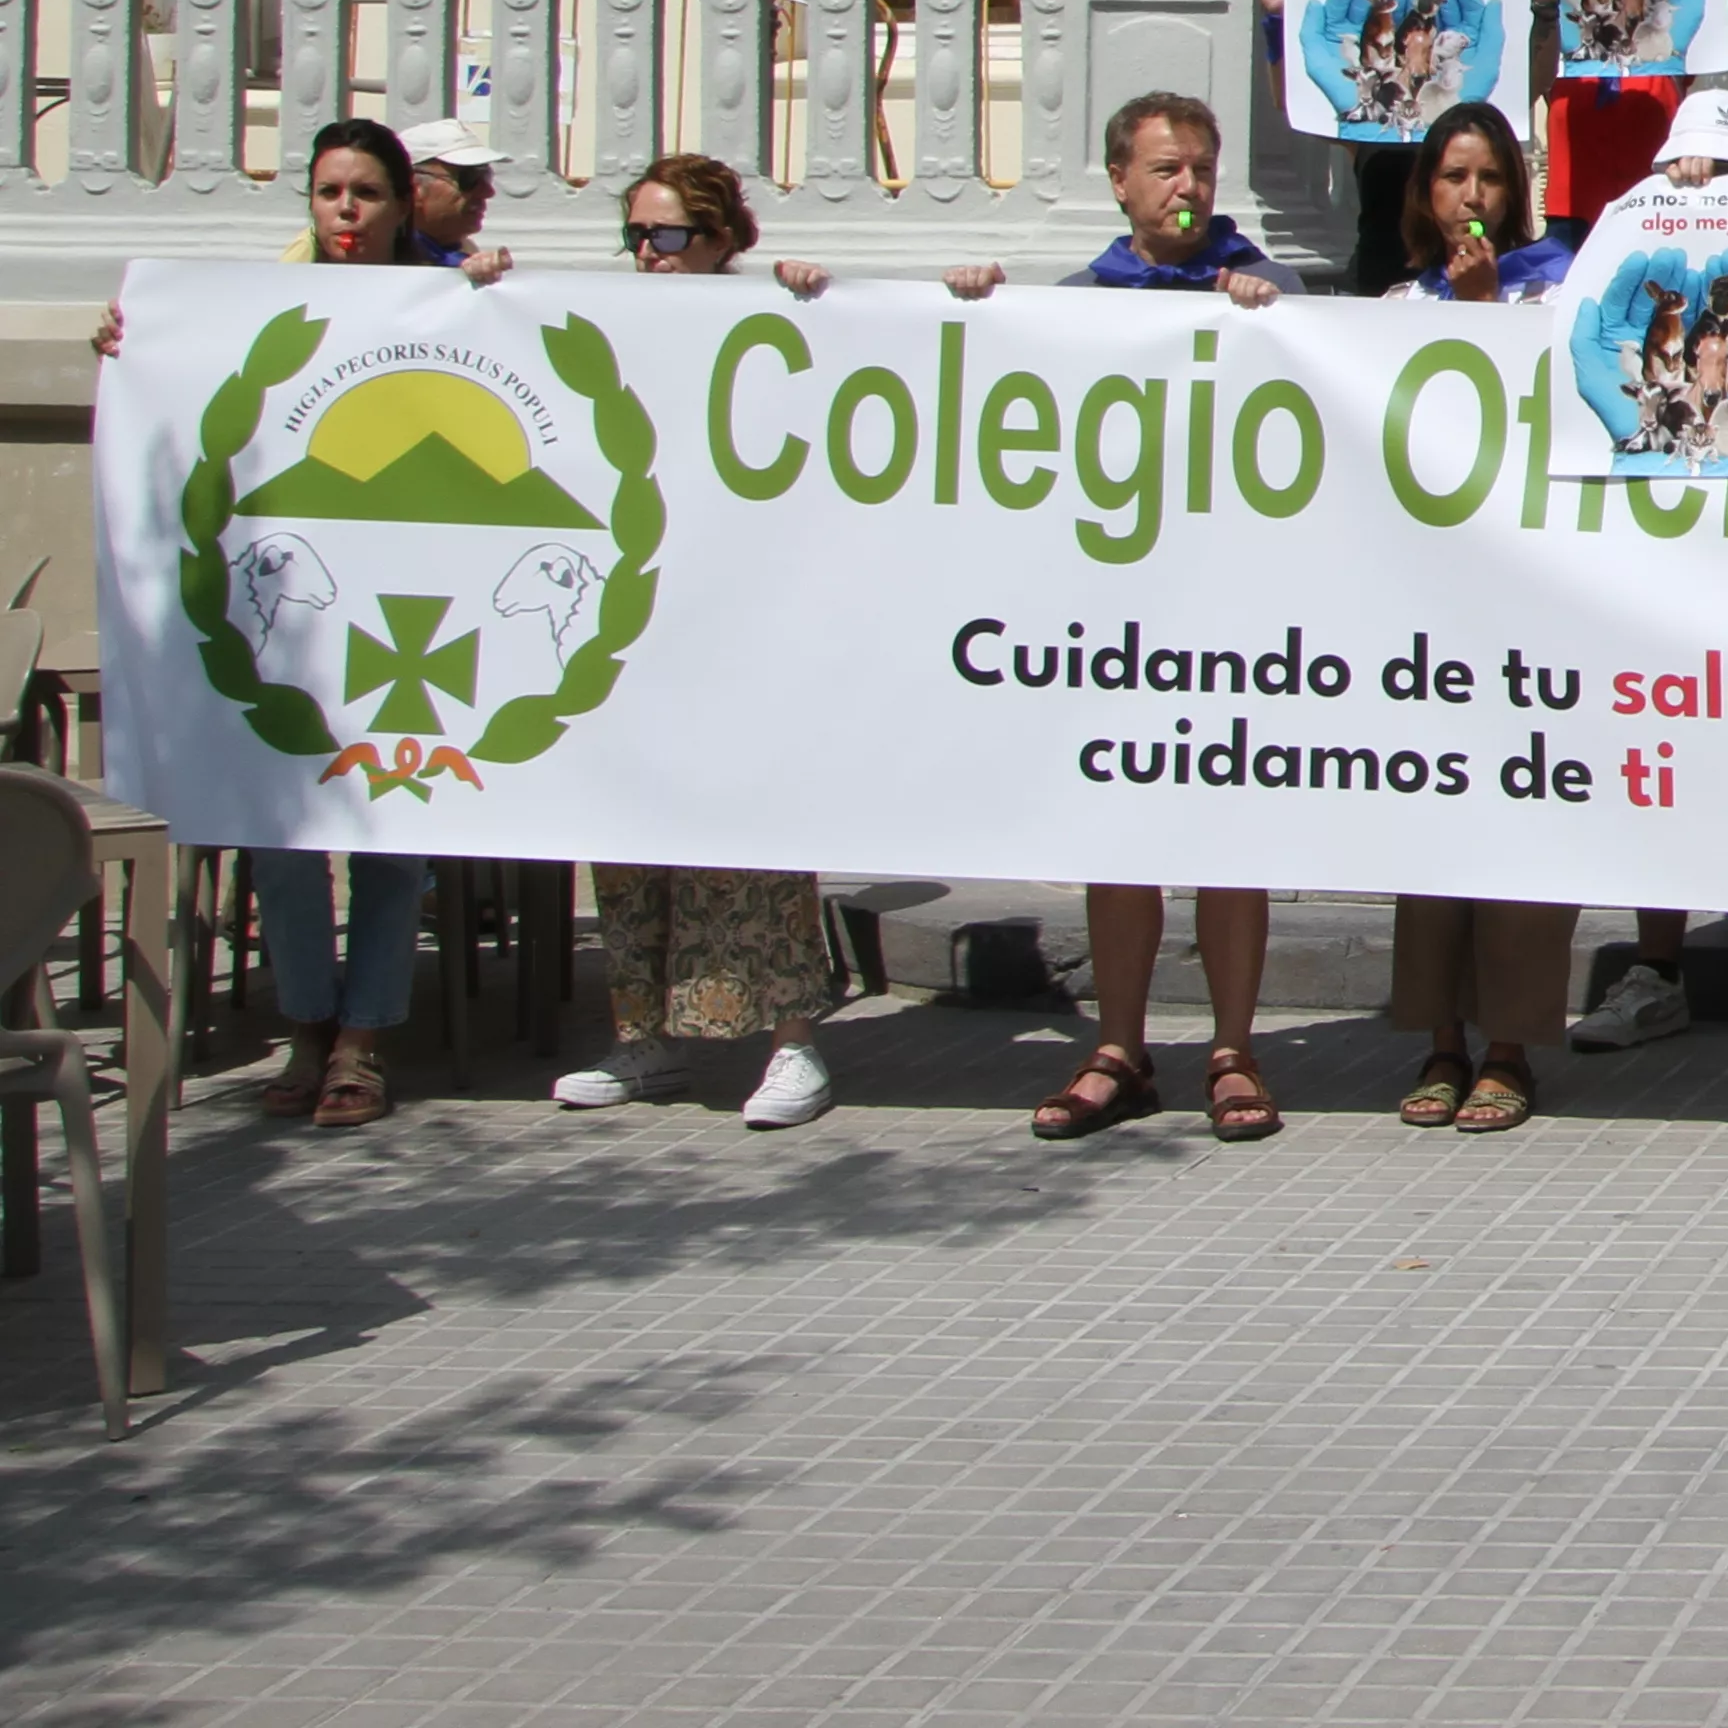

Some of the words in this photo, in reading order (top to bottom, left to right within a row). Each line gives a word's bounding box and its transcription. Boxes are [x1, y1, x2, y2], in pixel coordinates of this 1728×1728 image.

[1642, 213, 1688, 236] algo
[285, 377, 335, 434] HIGIA
[334, 343, 429, 381] PECORIS
[433, 343, 504, 379] SALUS
[502, 371, 559, 446] POPULI
[707, 312, 1326, 565] Colegio
[951, 617, 1353, 698] Cuidando
[1381, 632, 1476, 706] de
[1501, 649, 1582, 712] tu
[1078, 716, 1470, 797] cuidamos
[1499, 731, 1594, 803] de
[1620, 741, 1675, 808] ti
